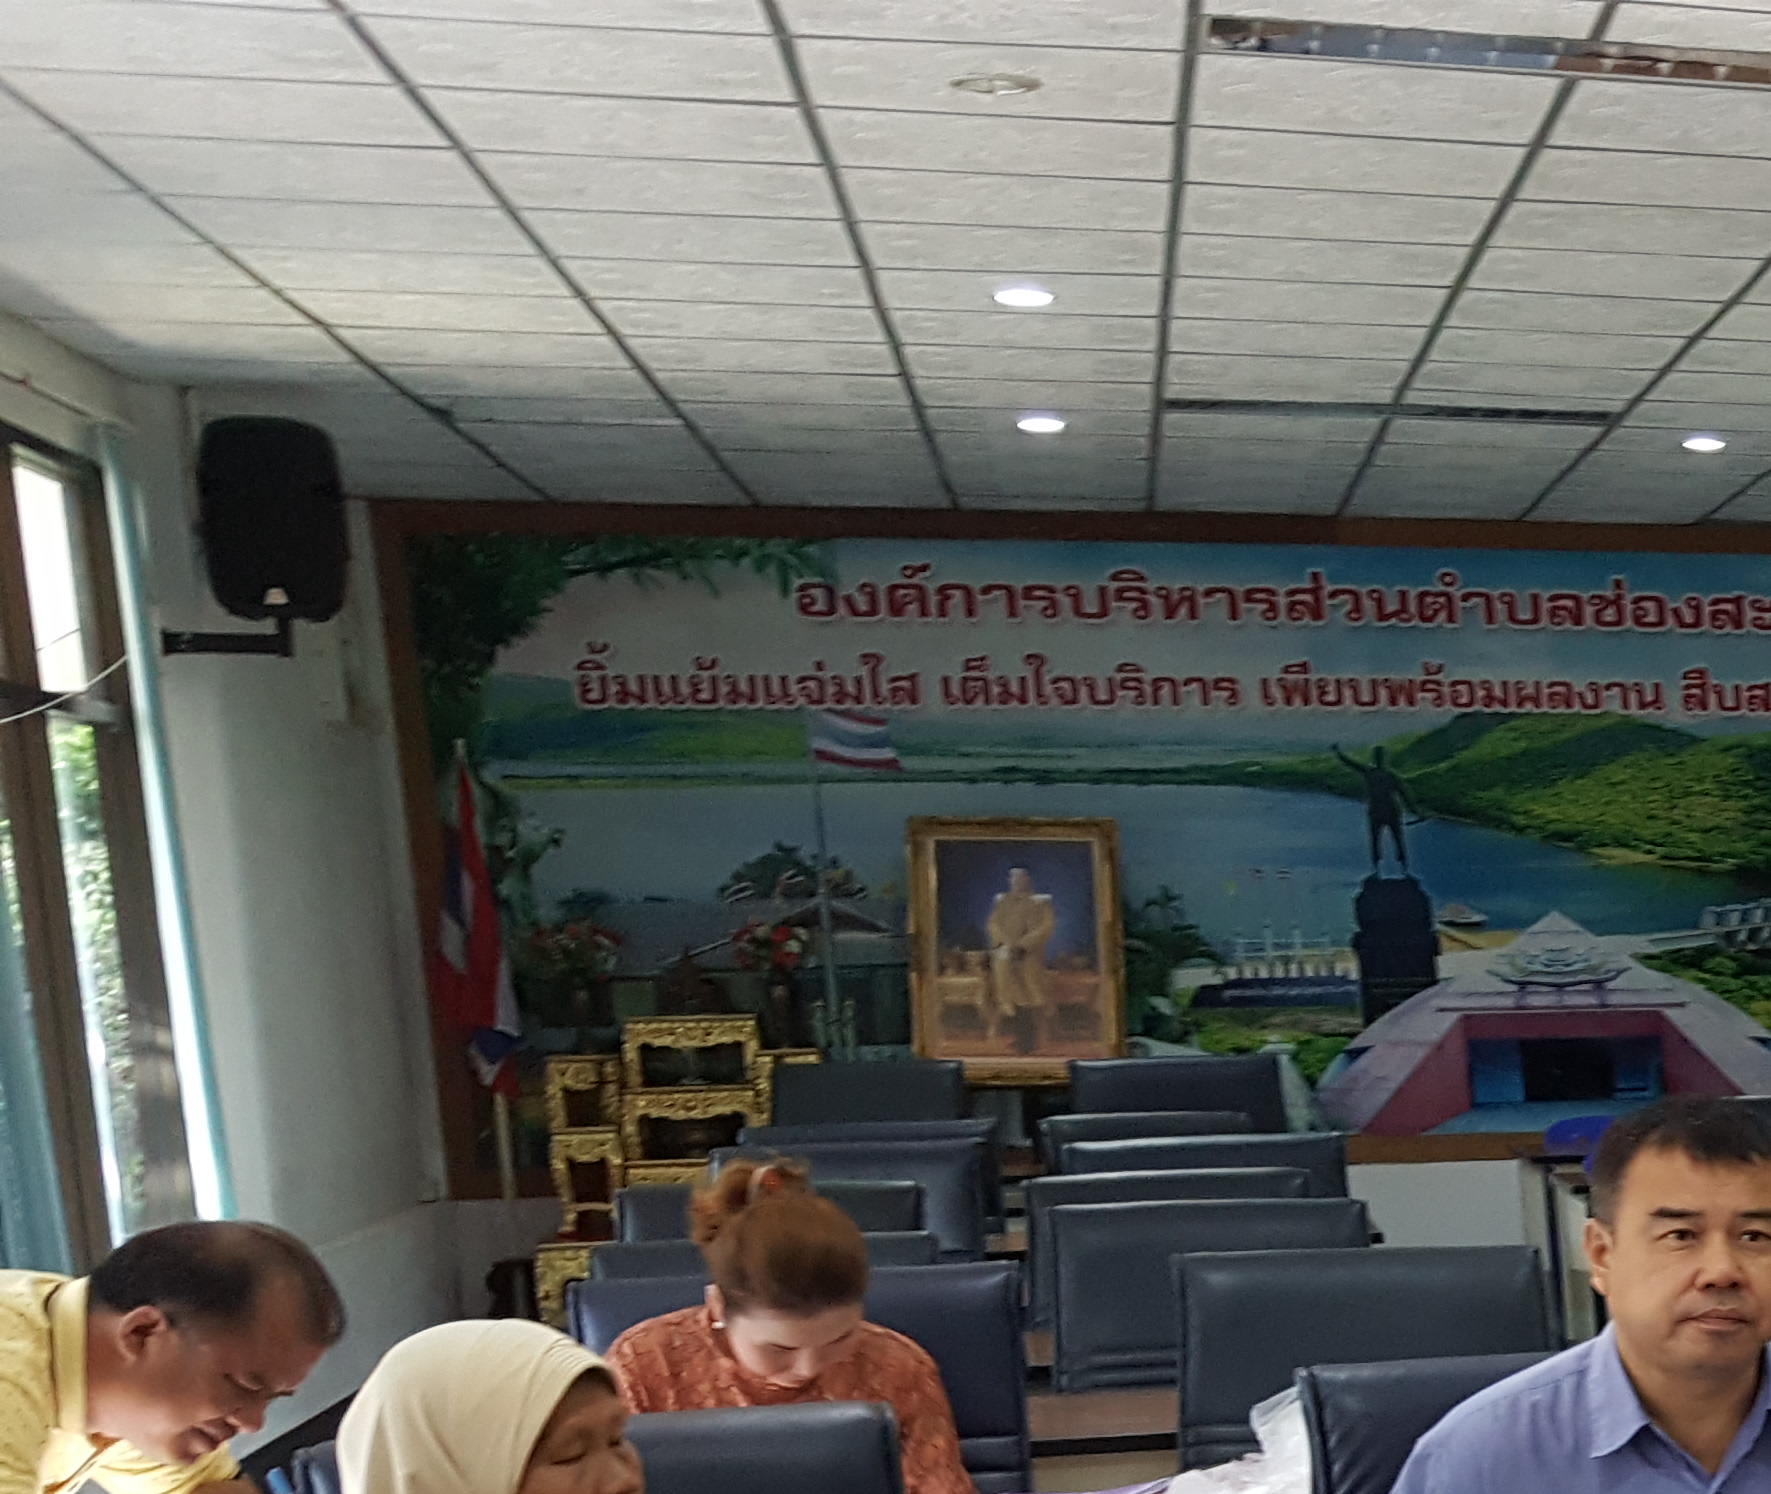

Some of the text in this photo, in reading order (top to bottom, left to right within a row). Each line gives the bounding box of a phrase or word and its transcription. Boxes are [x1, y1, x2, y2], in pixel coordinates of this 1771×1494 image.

[576, 639, 920, 708] ยิ้มแย้มแจ่มใส
[940, 653, 1239, 708] เต็มใจบริการ
[1259, 661, 1666, 713] เพียบพร้อมผลงาน
